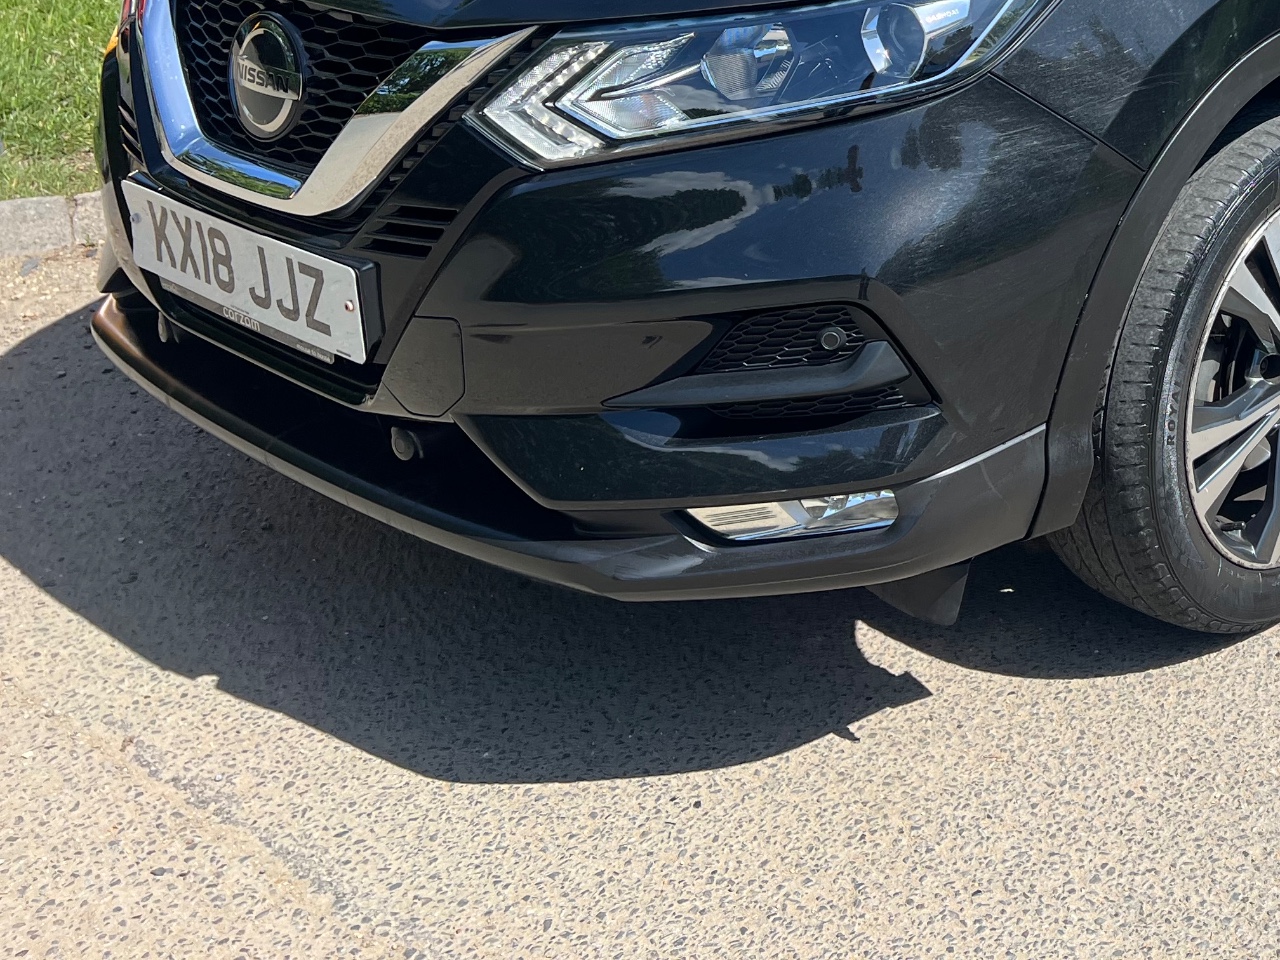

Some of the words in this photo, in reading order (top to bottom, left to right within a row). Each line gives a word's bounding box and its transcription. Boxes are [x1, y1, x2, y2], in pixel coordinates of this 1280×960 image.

[237, 62, 290, 93] NISSAN
[146, 199, 236, 294] KX18
[248, 245, 332, 337] JJZ
